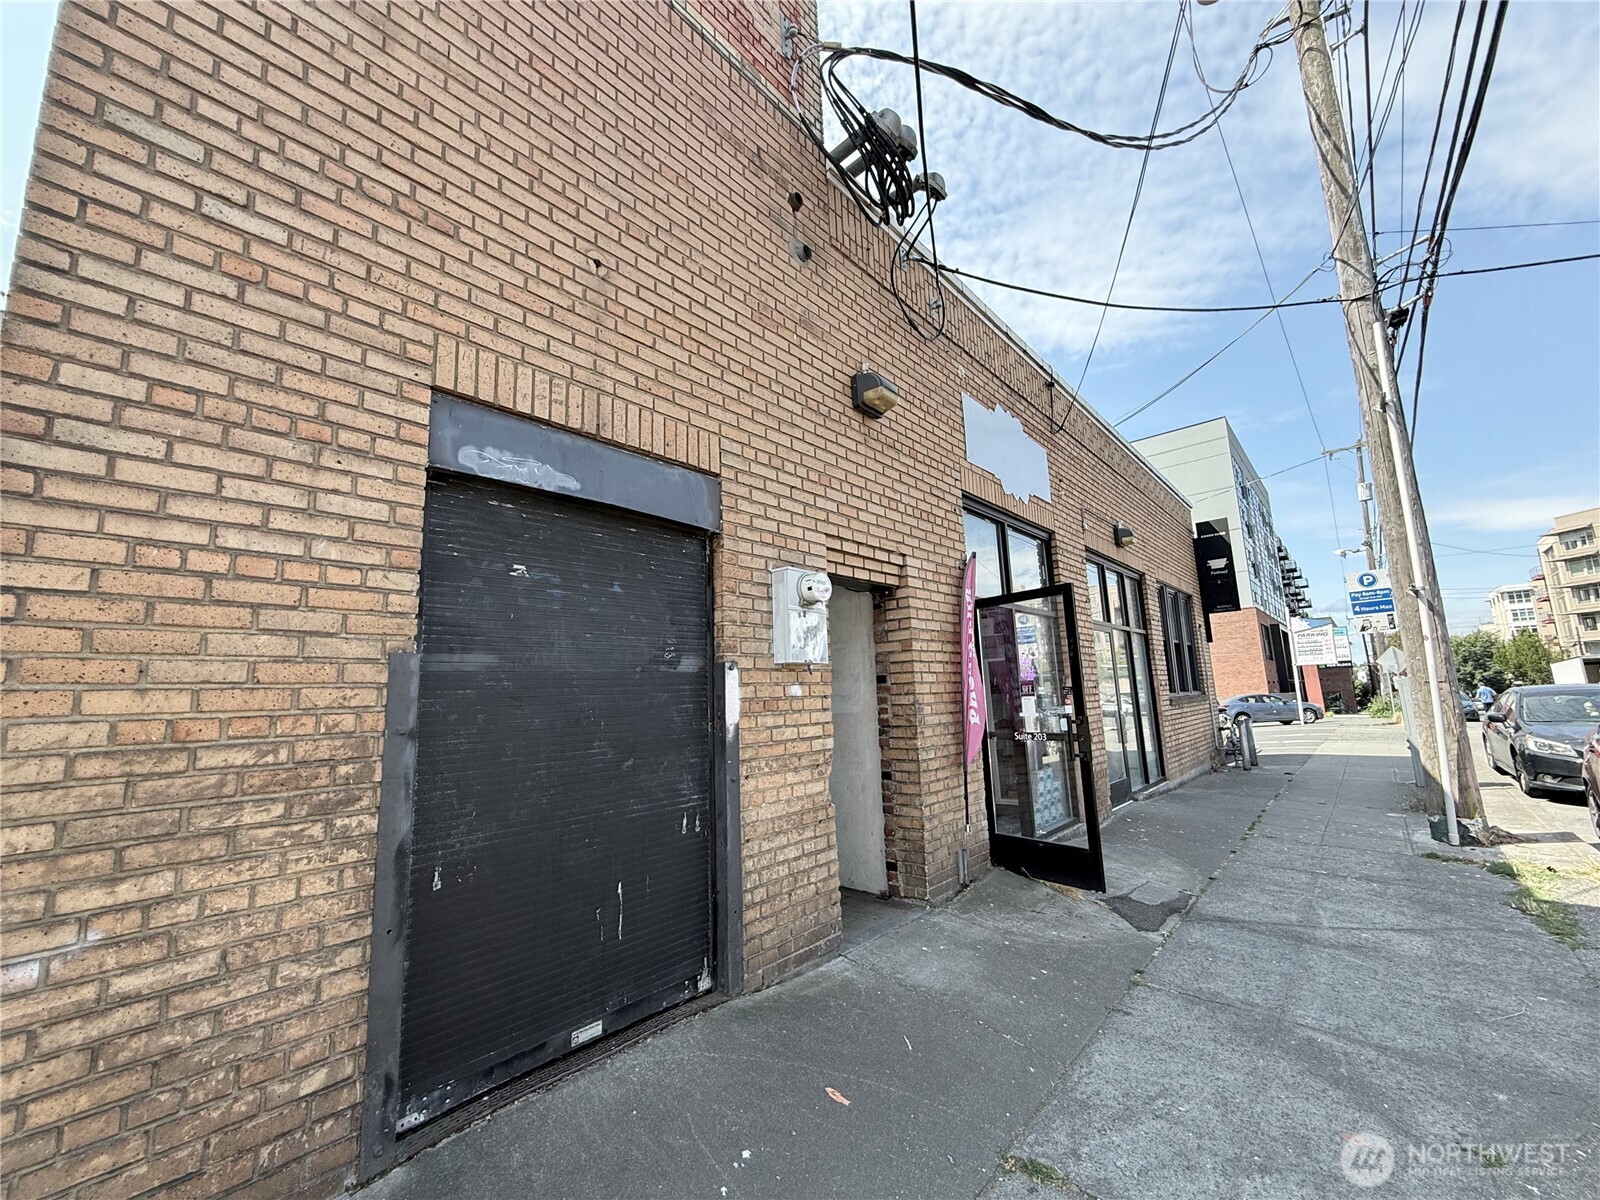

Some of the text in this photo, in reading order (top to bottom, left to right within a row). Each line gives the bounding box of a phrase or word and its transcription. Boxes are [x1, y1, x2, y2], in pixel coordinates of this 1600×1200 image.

[1362, 576, 1373, 586] P
[1014, 731, 1047, 741] Suite 203
